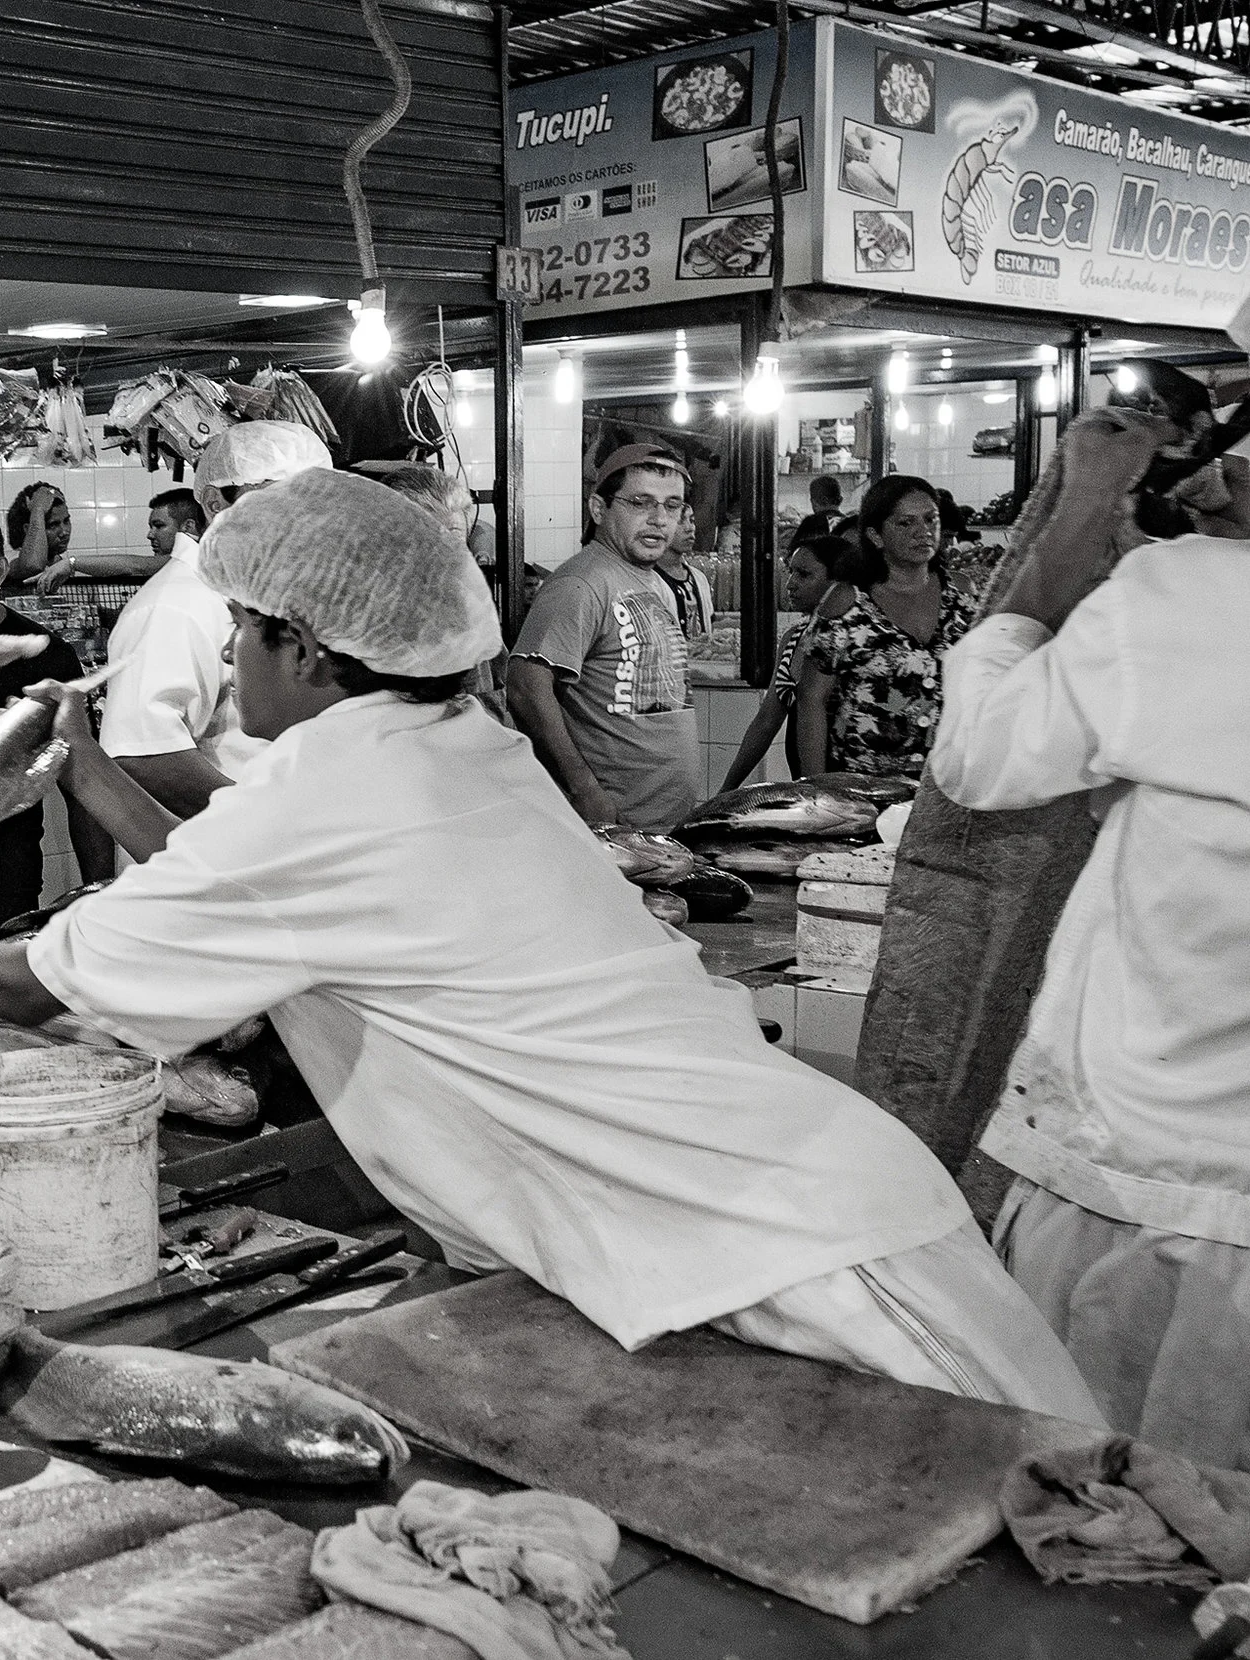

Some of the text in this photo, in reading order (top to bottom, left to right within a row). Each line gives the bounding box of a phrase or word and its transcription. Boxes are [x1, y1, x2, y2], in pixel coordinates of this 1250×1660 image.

[516, 92, 613, 149] Tucupi.
[1054, 107, 1123, 166] Camarão,
[1126, 126, 1193, 180] Bacalhau,
[518, 174, 566, 193] CEITAMOS
[569, 171, 583, 184] OS
[526, 206, 558, 224] VISA
[1010, 172, 1250, 273] asa Moraes
[996, 252, 1058, 275] SETOR AZUL
[607, 601, 640, 714] insano
